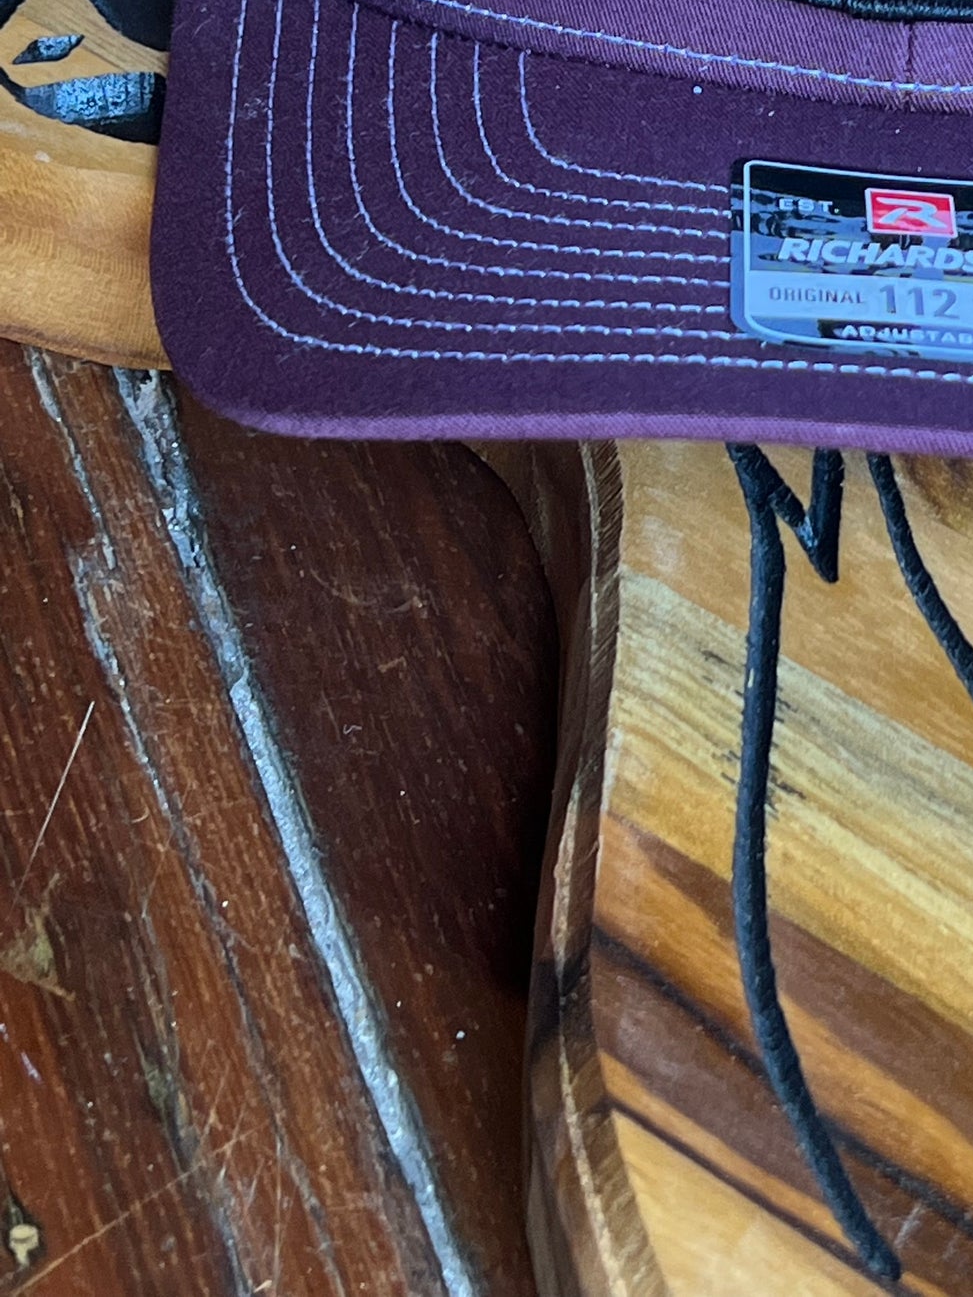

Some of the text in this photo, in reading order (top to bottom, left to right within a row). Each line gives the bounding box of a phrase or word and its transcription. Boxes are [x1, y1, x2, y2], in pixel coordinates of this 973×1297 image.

[778, 197, 840, 214] EST.
[768, 285, 866, 305] ORIGINAL
[879, 284, 960, 320] 112
